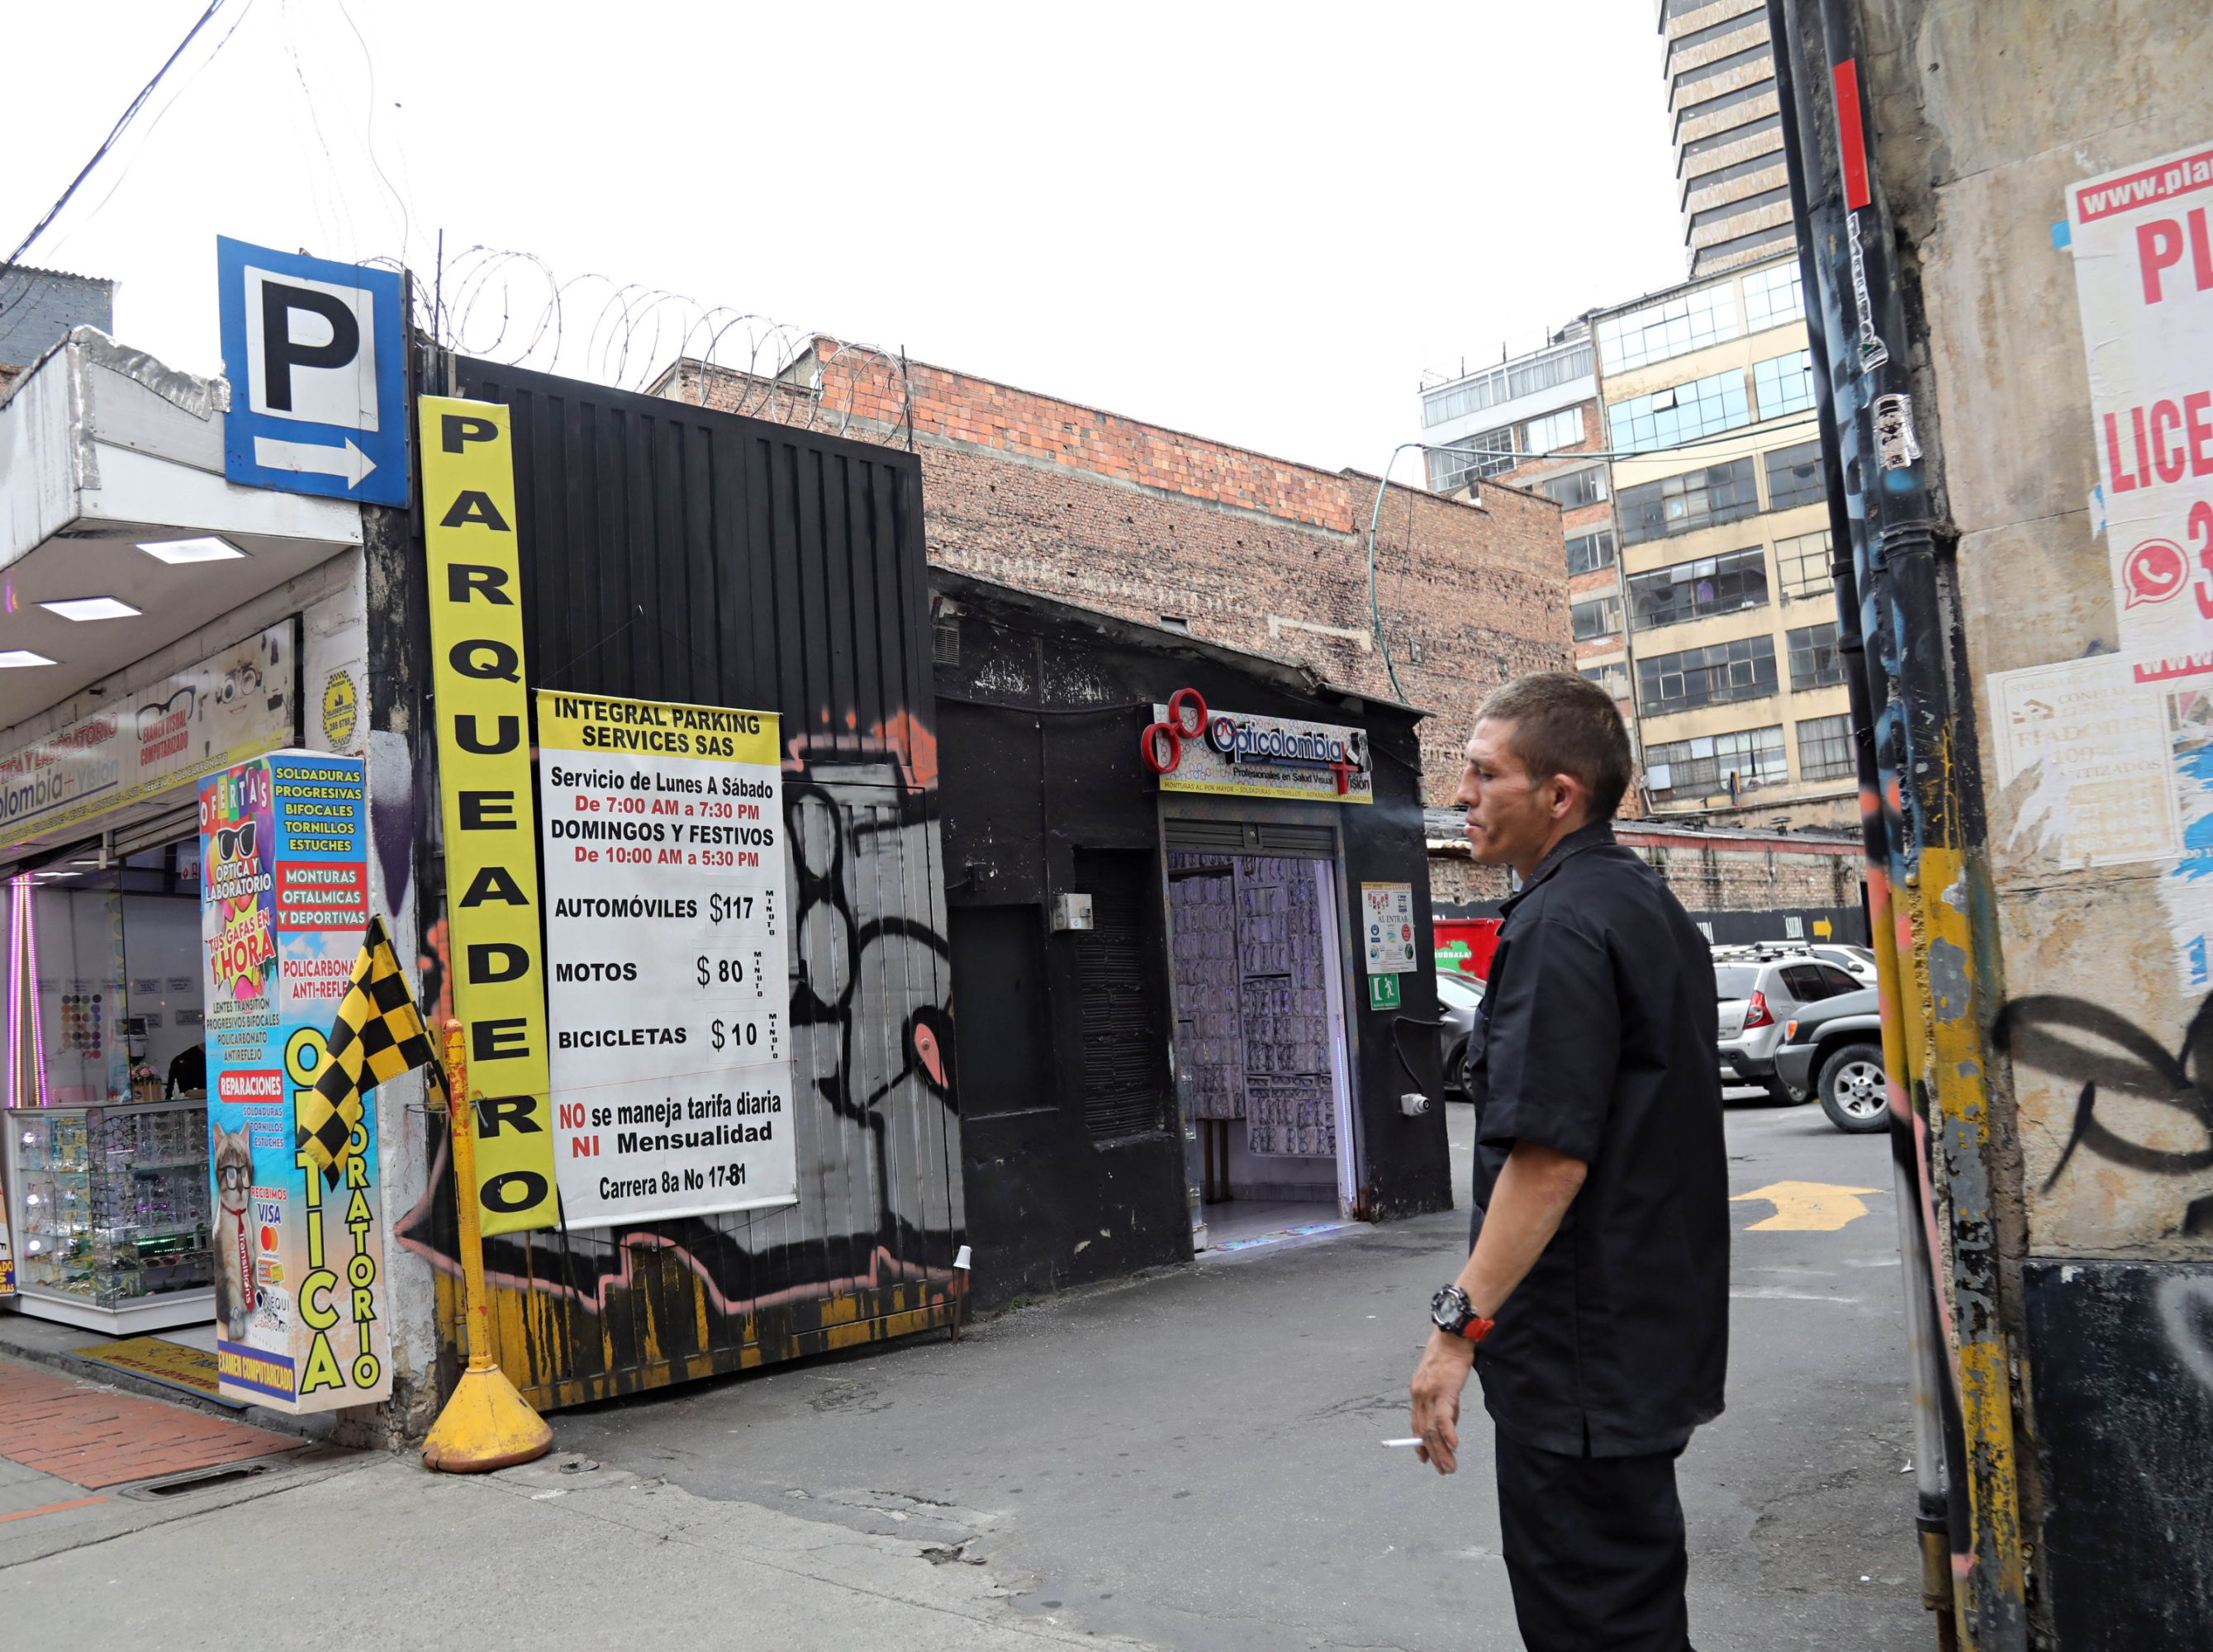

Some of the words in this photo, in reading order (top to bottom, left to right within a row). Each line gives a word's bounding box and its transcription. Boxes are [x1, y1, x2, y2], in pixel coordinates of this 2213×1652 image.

[2082, 158, 2213, 216] www.pla
[262, 279, 359, 411] P
[2103, 390, 2213, 495] LICE
[143, 718, 164, 744] EXAMEN
[166, 709, 186, 734] VISUAL
[554, 697, 667, 727] INTEGRAL
[672, 709, 760, 734] PARKING
[24, 750, 34, 774] Y
[35, 712, 118, 771] LABORATORIO
[141, 730, 188, 767] COMPUTARIZADO
[582, 725, 689, 753] SERVICES
[696, 735, 734, 757] SAS
[1212, 715, 1343, 763] Opticolombia
[173, 752, 228, 783] POLICARBONATO
[276, 767, 360, 782] SOLDADURAS
[1233, 767, 1280, 781] Profesionales
[1282, 772, 1290, 781] en
[1292, 772, 1312, 783] Salud
[1313, 774, 1333, 785] Visual
[275, 786, 362, 800] PROGRESIVAS
[551, 767, 624, 789] Servicio
[630, 771, 651, 790] de
[657, 772, 702, 794] Lunes
[707, 776, 718, 795] A
[722, 777, 773, 799] Sábado
[1164, 781, 1194, 790] MONTURAS
[1216, 785, 1234, 793] MAYOR
[201, 778, 268, 826] OFERTAS
[285, 804, 354, 817] BIFOCALES
[575, 795, 601, 812] De
[606, 797, 645, 814] 7:00
[652, 800, 679, 815] AM
[685, 803, 694, 816] a
[699, 802, 733, 818] 7:30
[738, 803, 760, 819] PM
[439, 414, 549, 1213] PARQUEADERO
[285, 821, 354, 834] TORNILLOS
[551, 819, 665, 842] DOMINGOS
[671, 824, 684, 843] Y
[689, 824, 774, 847] FESTIVOS
[289, 839, 352, 852] ESTUCHES
[575, 847, 599, 862] De
[605, 847, 653, 864] 10:00
[658, 848, 682, 865] AM
[688, 853, 697, 866] a
[701, 850, 734, 866] 5:30
[738, 852, 759, 867] PM
[216, 862, 249, 881] OPTICA
[251, 857, 259, 873] Y
[286, 870, 356, 883] MONTURAS
[206, 873, 272, 902] LABORATORIO
[283, 890, 361, 904] OFTALMICAS
[278, 912, 287, 925] Y
[290, 911, 365, 924] DEPORTIVAS
[554, 895, 698, 919] AUTOMÓVILES
[710, 892, 753, 926] $117
[208, 932, 224, 952] TUS
[226, 916, 254, 942] GAFAS
[257, 909, 270, 928] EN
[211, 958, 217, 985] 1
[221, 928, 276, 981] HORA
[283, 959, 357, 978] POLICARBONA
[556, 963, 638, 982] MOTOS
[292, 980, 347, 999] ANTI-REFLE
[213, 1001, 233, 1014] LENTES
[234, 998, 270, 1013] TRANSITION
[207, 1016, 245, 1029] PROGRESIVOS
[247, 1014, 279, 1028] BIFOCALES
[217, 1032, 268, 1046] POLICARBONATO
[558, 1027, 687, 1049] BICICLETAS
[224, 1048, 262, 1062] ANTIREFLEJO
[221, 1076, 281, 1096] REPARACIONES
[243, 1107, 283, 1117] SOLDADURAS
[559, 1102, 586, 1130] NO
[591, 1108, 612, 1127] se
[617, 1097, 681, 1128] maneja
[687, 1093, 733, 1120] tarifa
[736, 1089, 781, 1117] diaria
[249, 1122, 283, 1132] TORNILLOS
[254, 1137, 283, 1147] ESTUCHES
[572, 1135, 600, 1158] NI
[617, 1121, 772, 1154] Mensualidad
[599, 1176, 657, 1200] Carrera
[662, 1170, 680, 1193] 8a
[684, 1168, 704, 1191] No
[709, 1162, 745, 1188] 17-81
[250, 1186, 287, 1200] RECIBIMOS
[257, 1203, 281, 1224] VISA
[345, 1093, 381, 1389] ORATORIO
[264, 1294, 289, 1311] NEQUI
[218, 1351, 242, 1377] EXAMEN
[243, 1357, 293, 1393] COMPUTARIZADO
